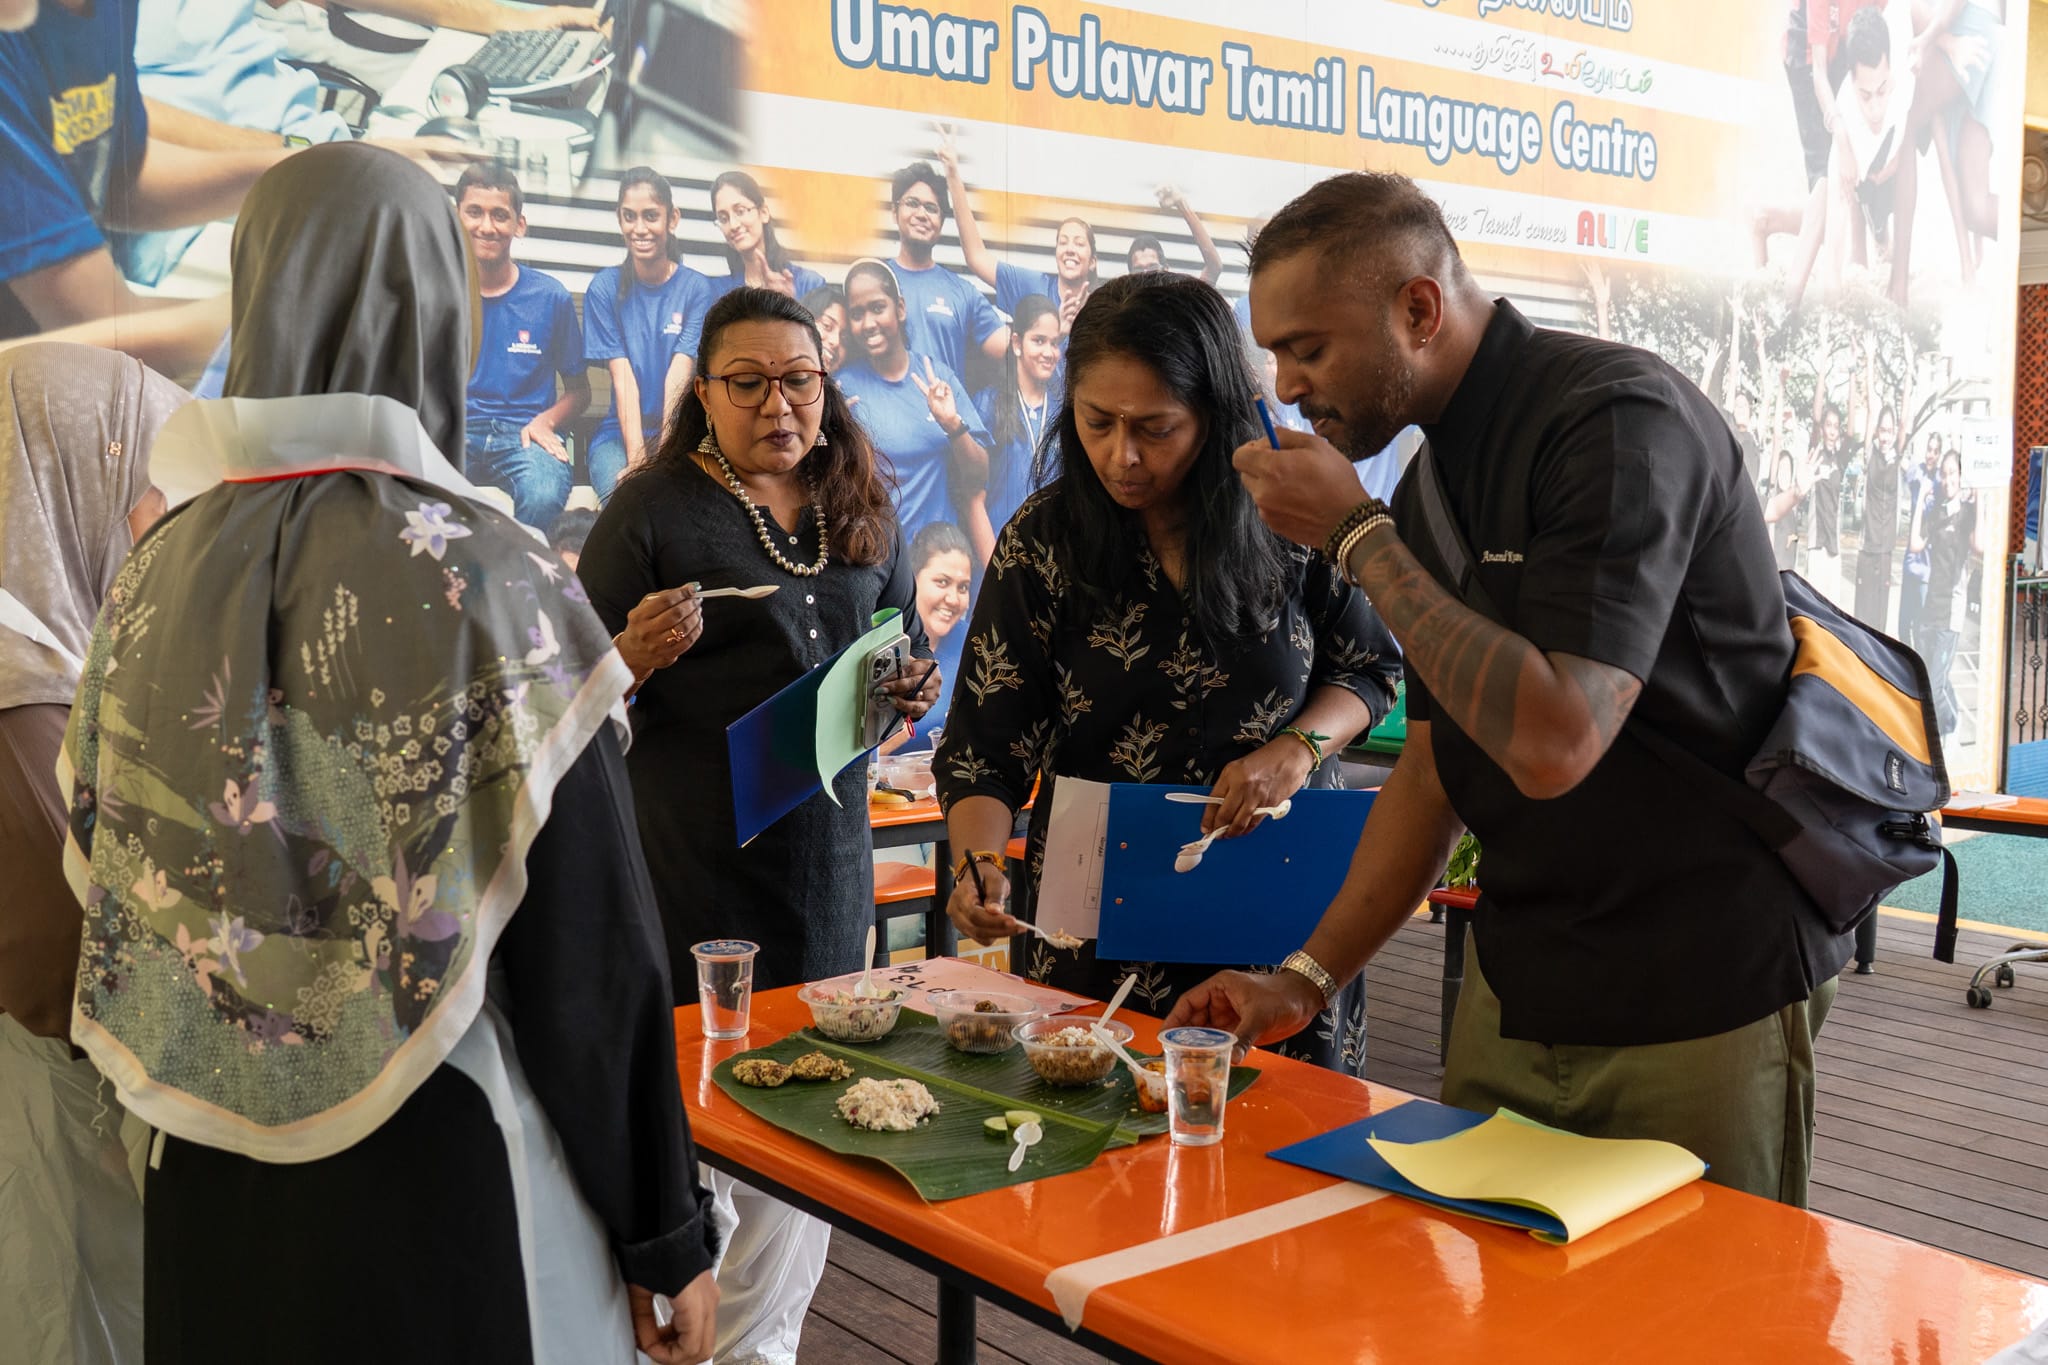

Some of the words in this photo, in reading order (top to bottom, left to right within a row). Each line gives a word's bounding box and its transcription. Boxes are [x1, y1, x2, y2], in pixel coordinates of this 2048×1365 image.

[831, 0, 999, 85] Umar
[1012, 5, 1213, 116] Pulavar
[1222, 41, 1345, 135] Tamil
[1357, 66, 1542, 175] Language
[1550, 100, 1657, 181] Centre
[1473, 206, 1522, 237] Tamil
[1526, 223, 1567, 243] comes
